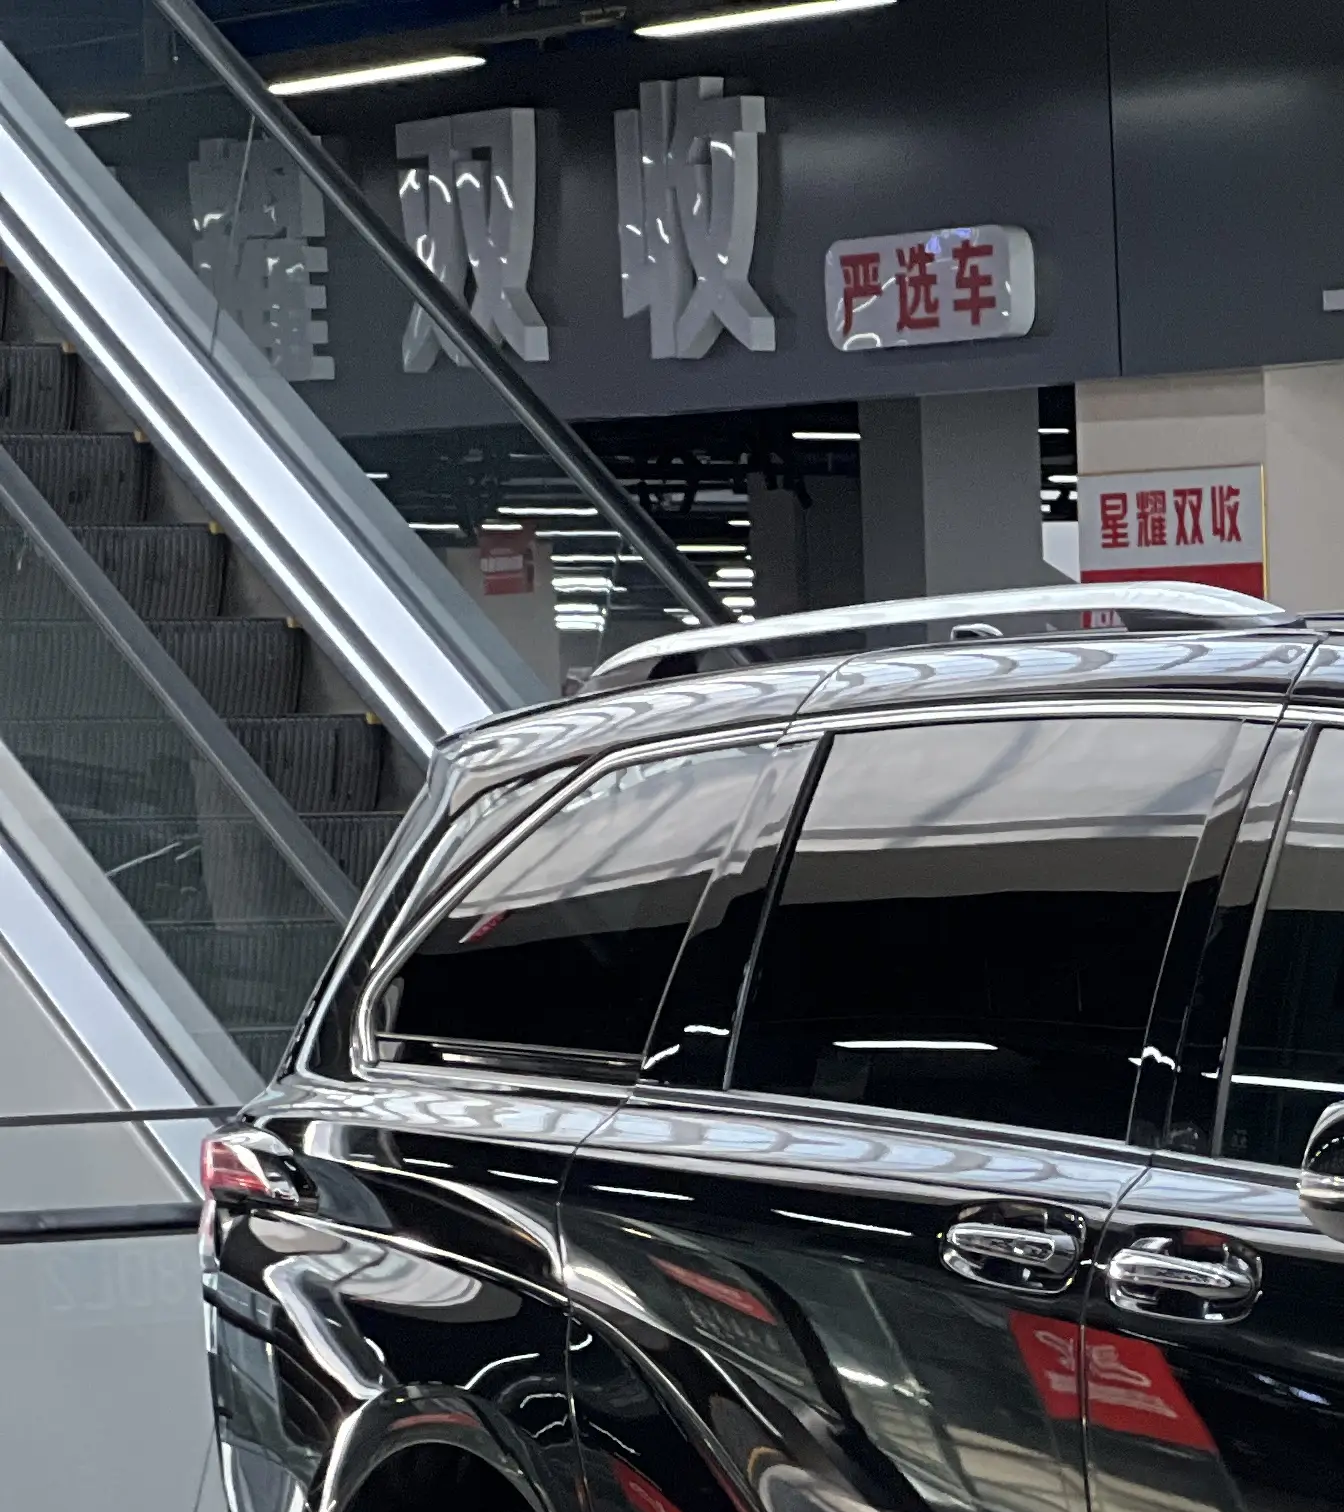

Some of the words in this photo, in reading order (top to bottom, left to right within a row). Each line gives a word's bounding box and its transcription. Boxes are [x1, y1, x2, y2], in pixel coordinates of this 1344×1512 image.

[839, 239, 997, 335] 严选车
[1100, 484, 1242, 549] 星耀双收
